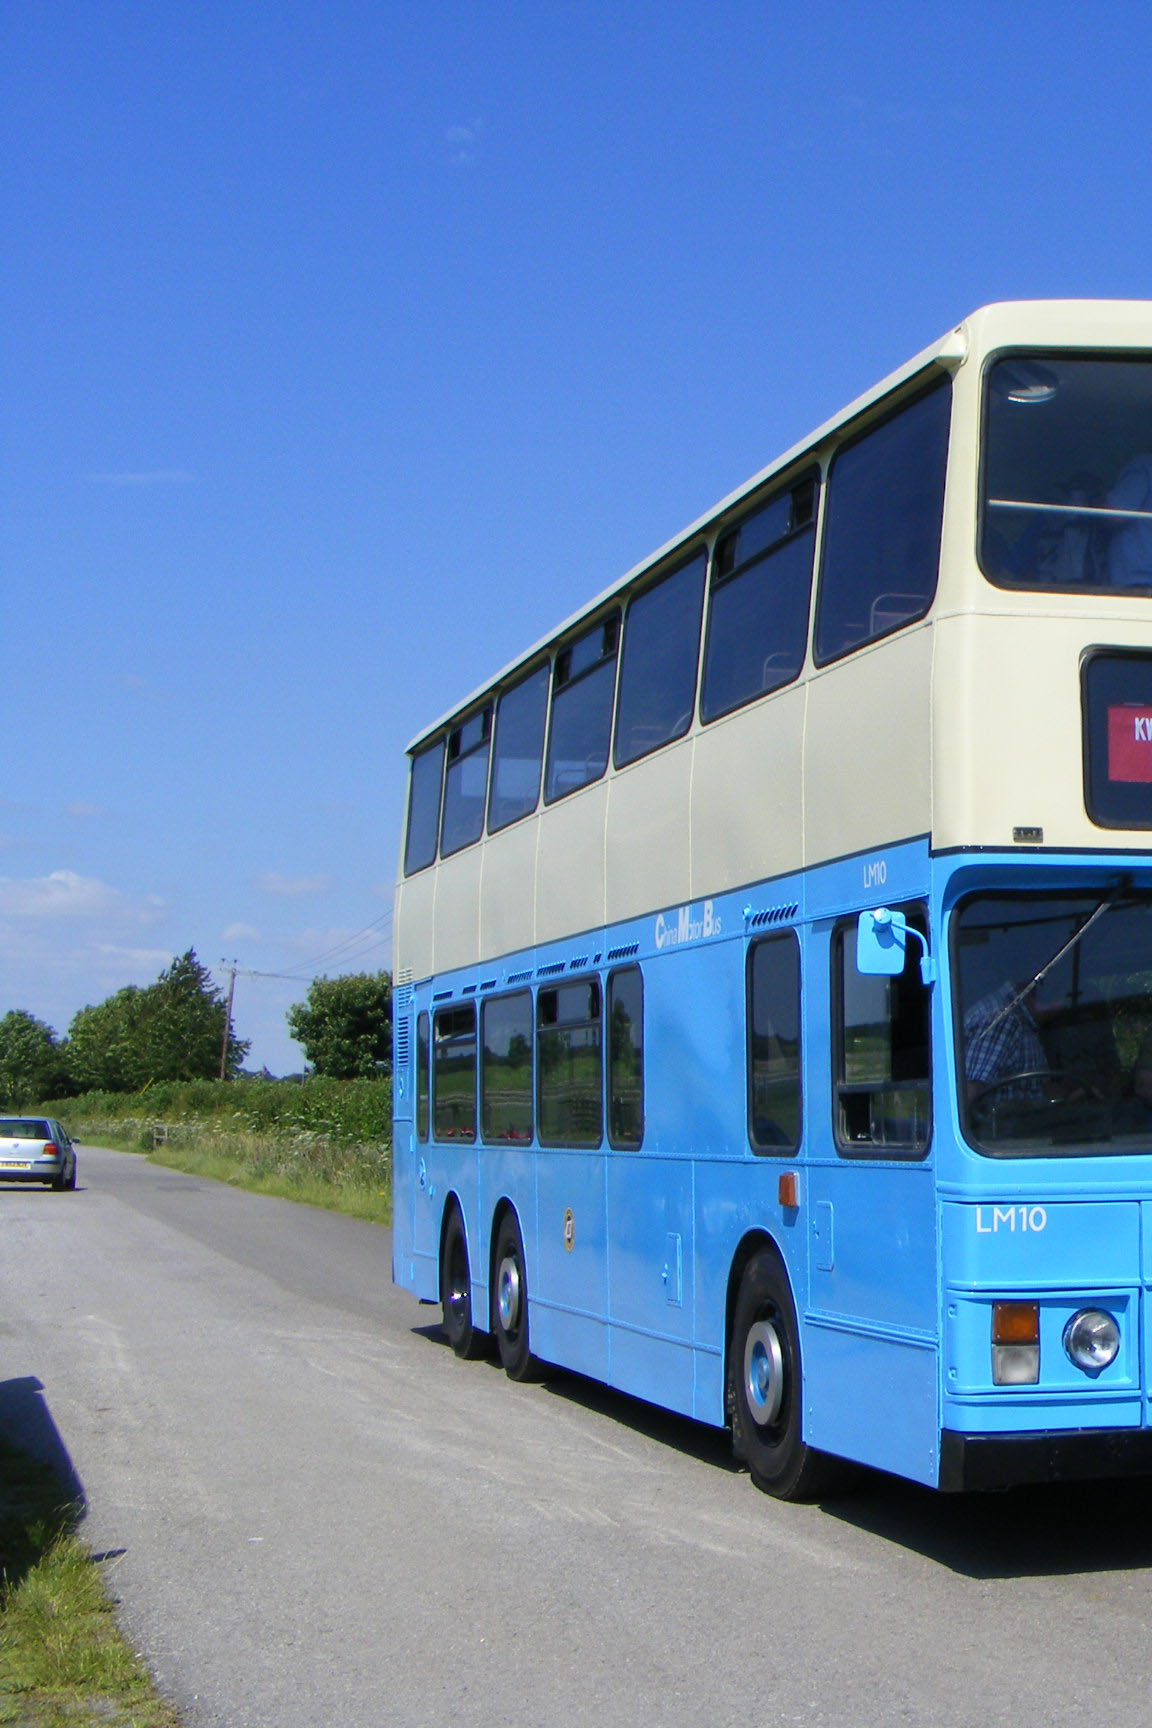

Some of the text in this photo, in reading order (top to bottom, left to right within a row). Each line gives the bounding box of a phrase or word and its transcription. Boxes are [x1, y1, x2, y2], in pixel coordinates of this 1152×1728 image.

[863, 860, 887, 888] LM10
[703, 899, 722, 938] Bus
[975, 1206, 1048, 1233] LM10
